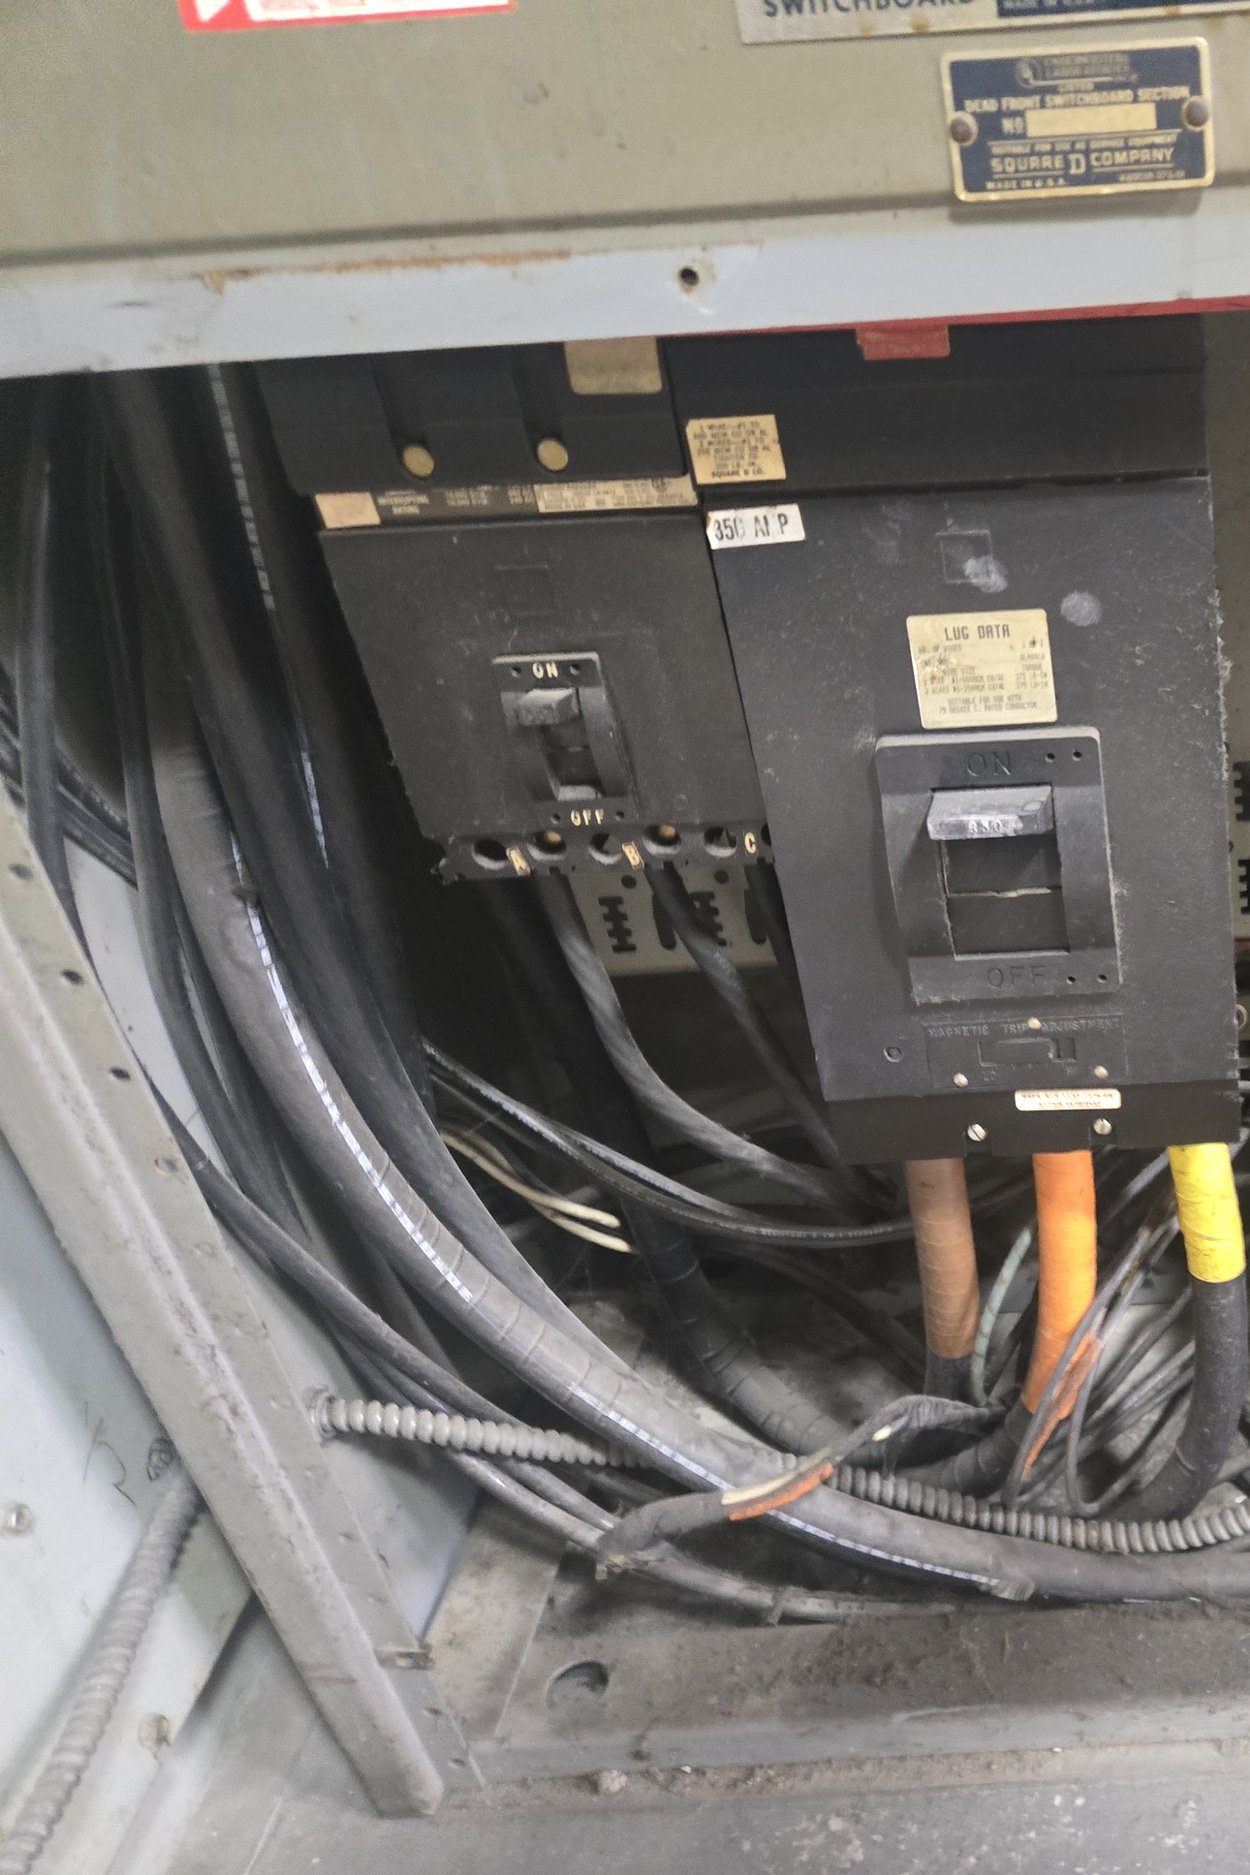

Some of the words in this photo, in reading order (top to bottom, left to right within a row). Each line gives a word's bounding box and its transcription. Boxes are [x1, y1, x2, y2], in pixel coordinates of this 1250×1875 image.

[763, 0, 974, 18] SWITCH
[1001, 95, 1041, 110] FRONT
[1044, 89, 1134, 109] SWITCHBOARD
[990, 153, 1064, 174] SQUARE
[1069, 152, 1086, 175] D
[1089, 146, 1174, 167] COMPANY
[944, 625, 969, 641] LUG
[978, 623, 1011, 639] DATA
[532, 662, 559, 679] ON
[967, 751, 1012, 777] ON
[570, 808, 604, 826] OFF
[744, 832, 757, 854] C
[986, 965, 1047, 987] OFF
[927, 1024, 989, 1038] MAGNETIC
[1001, 1022, 1029, 1034] TRIP
[1041, 1017, 1120, 1032] ADJUSTMENT
